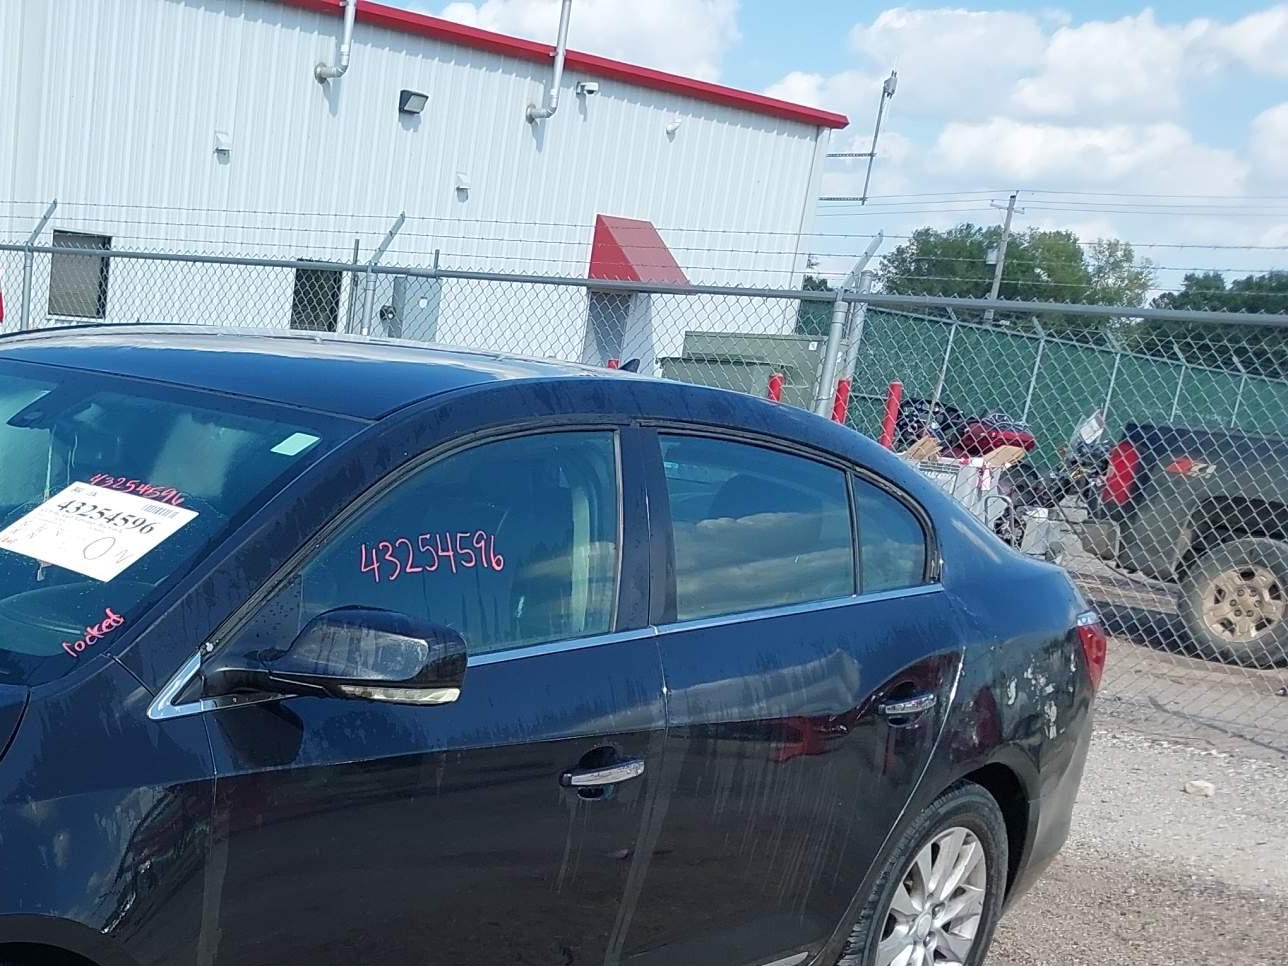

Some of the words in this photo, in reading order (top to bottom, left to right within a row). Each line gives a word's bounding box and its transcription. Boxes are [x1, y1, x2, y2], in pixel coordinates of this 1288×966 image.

[90, 473, 185, 506] 43254596
[57, 499, 159, 535] 43254596
[361, 530, 504, 582] 43254596
[61, 607, 125, 657] locked
